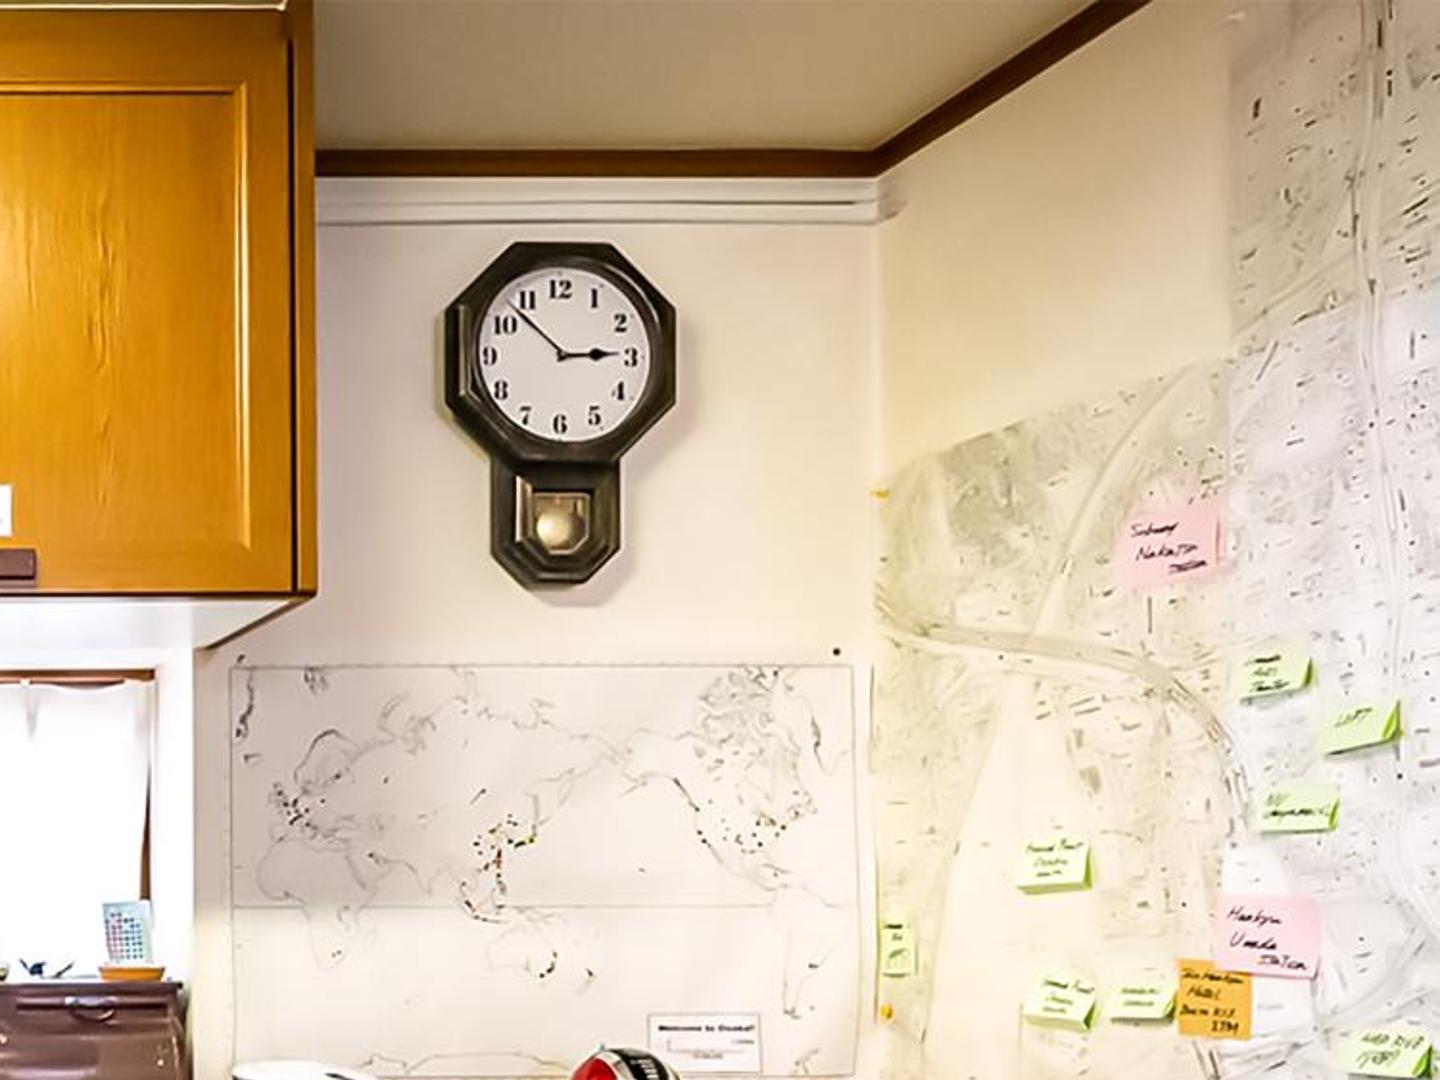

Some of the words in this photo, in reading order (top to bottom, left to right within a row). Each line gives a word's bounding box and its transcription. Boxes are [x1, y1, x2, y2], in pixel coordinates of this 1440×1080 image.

[549, 280, 572, 299] 12
[591, 288, 598, 308] 1
[520, 290, 536, 310] 11
[494, 315, 517, 334] 10
[614, 313, 627, 333] 2
[483, 347, 497, 366] 9
[624, 348, 637, 367] 3
[494, 380, 508, 399] 8
[612, 381, 624, 400] 4
[520, 406, 532, 425] 7
[553, 414, 567, 434] 6
[588, 406, 601, 425] 5
